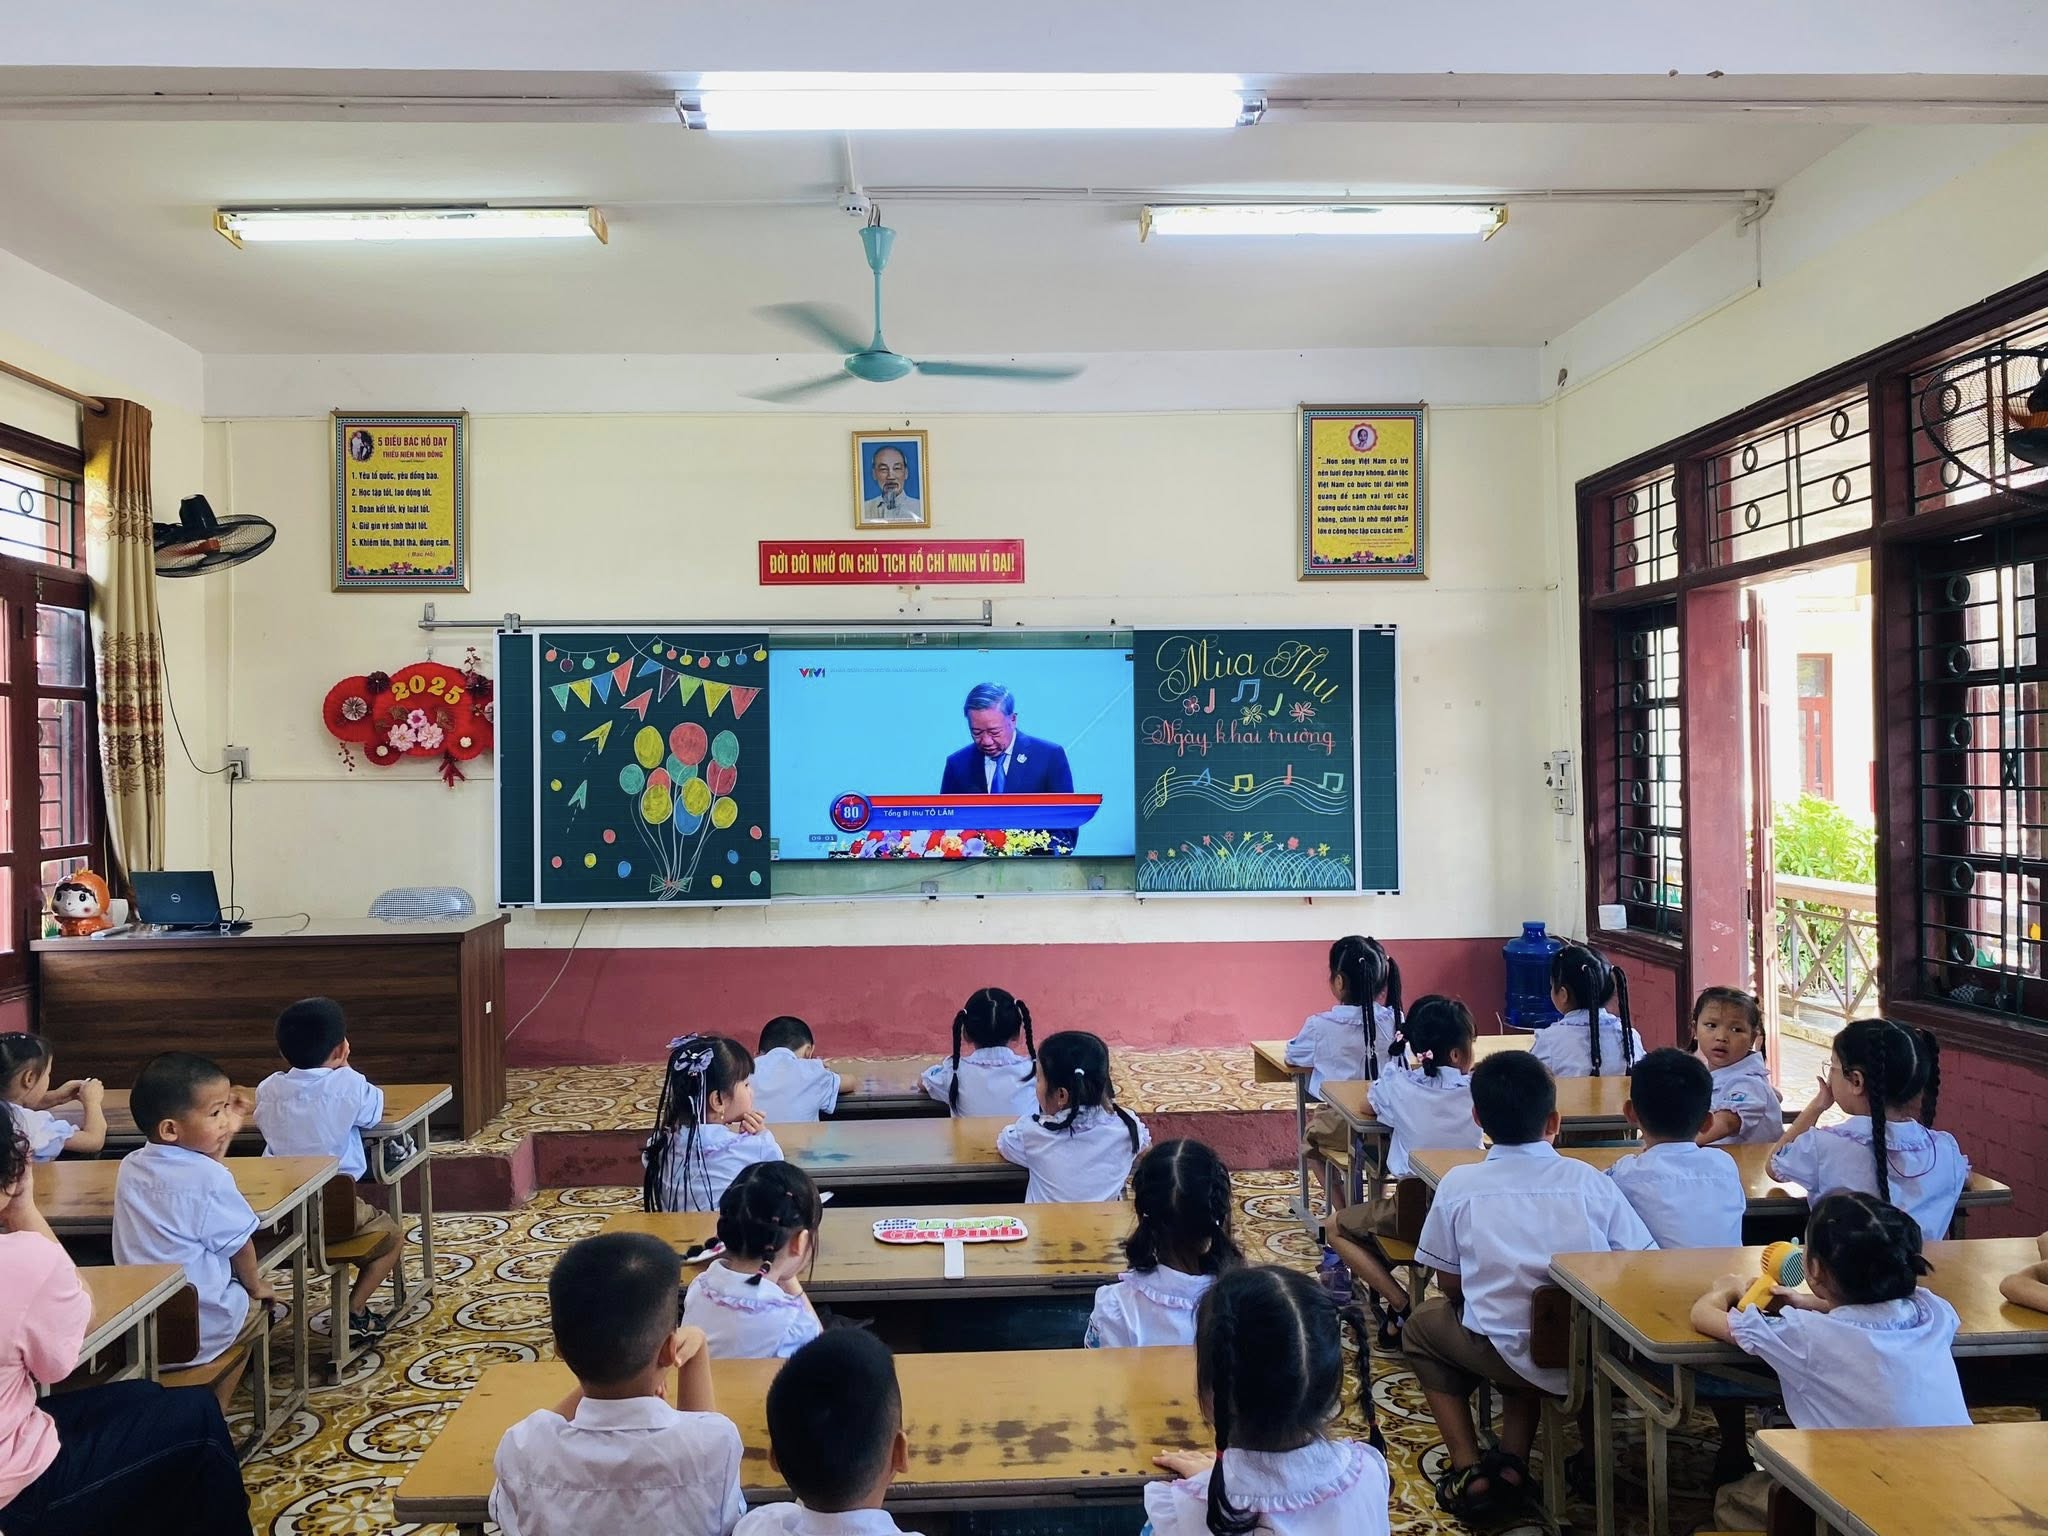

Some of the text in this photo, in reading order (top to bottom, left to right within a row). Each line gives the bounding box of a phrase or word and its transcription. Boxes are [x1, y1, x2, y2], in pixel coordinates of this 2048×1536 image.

[378, 437, 382, 446] 5
[769, 547, 1015, 577] ĐỜI ĐỜI NHỚ ƠN CHỦ TỊCH HỒ CHÍ MINH VĨ ĐẠI!
[799, 667, 826, 678] VTV1
[1156, 634, 1340, 703] Mùa Thu
[391, 675, 465, 705] 2025
[1142, 716, 1336, 757] Ngày khai trường
[843, 806, 859, 819] 80
[884, 809, 901, 818] Tổng
[938, 808, 954, 816] LÂM
